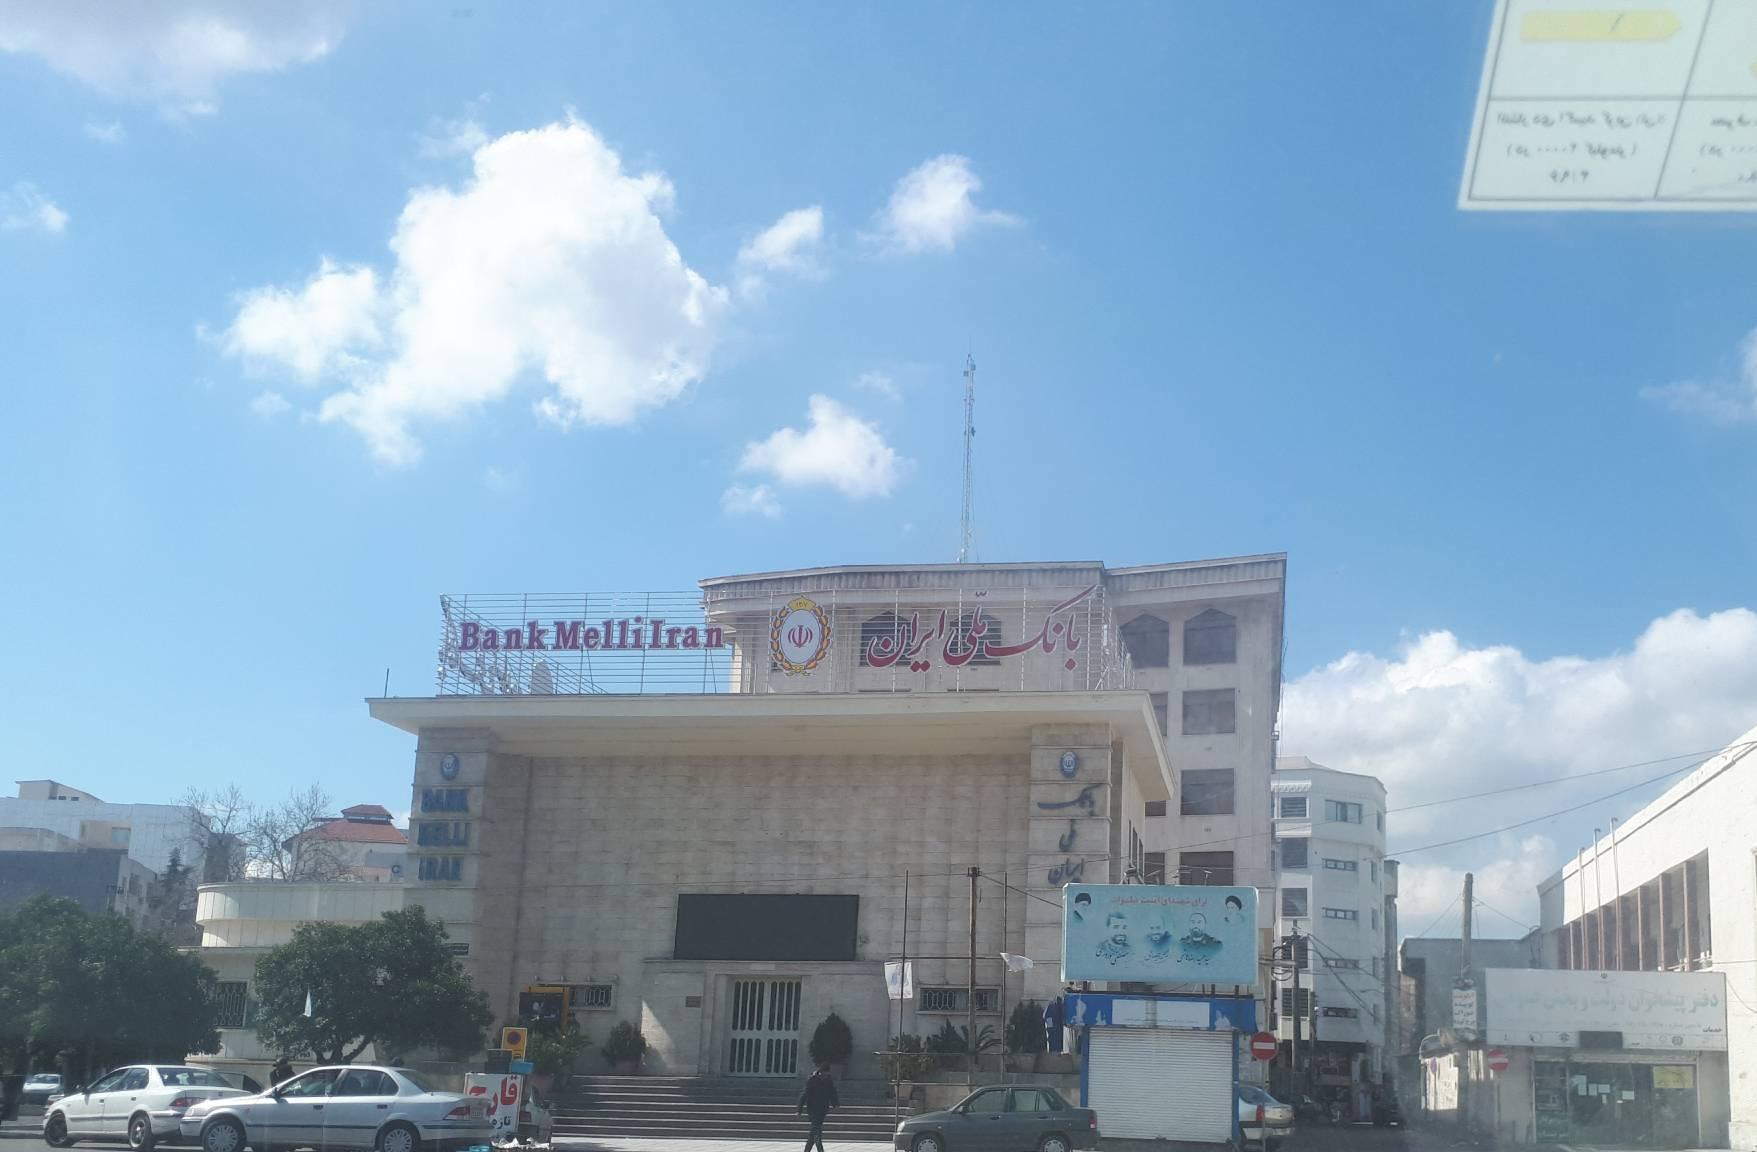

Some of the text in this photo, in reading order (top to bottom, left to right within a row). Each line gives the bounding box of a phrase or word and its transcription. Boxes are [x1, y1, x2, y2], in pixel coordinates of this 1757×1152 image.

[458, 616, 725, 651] Bank Melli Iran
[867, 609, 948, 673] ایران
[984, 584, 1098, 672] بانک
